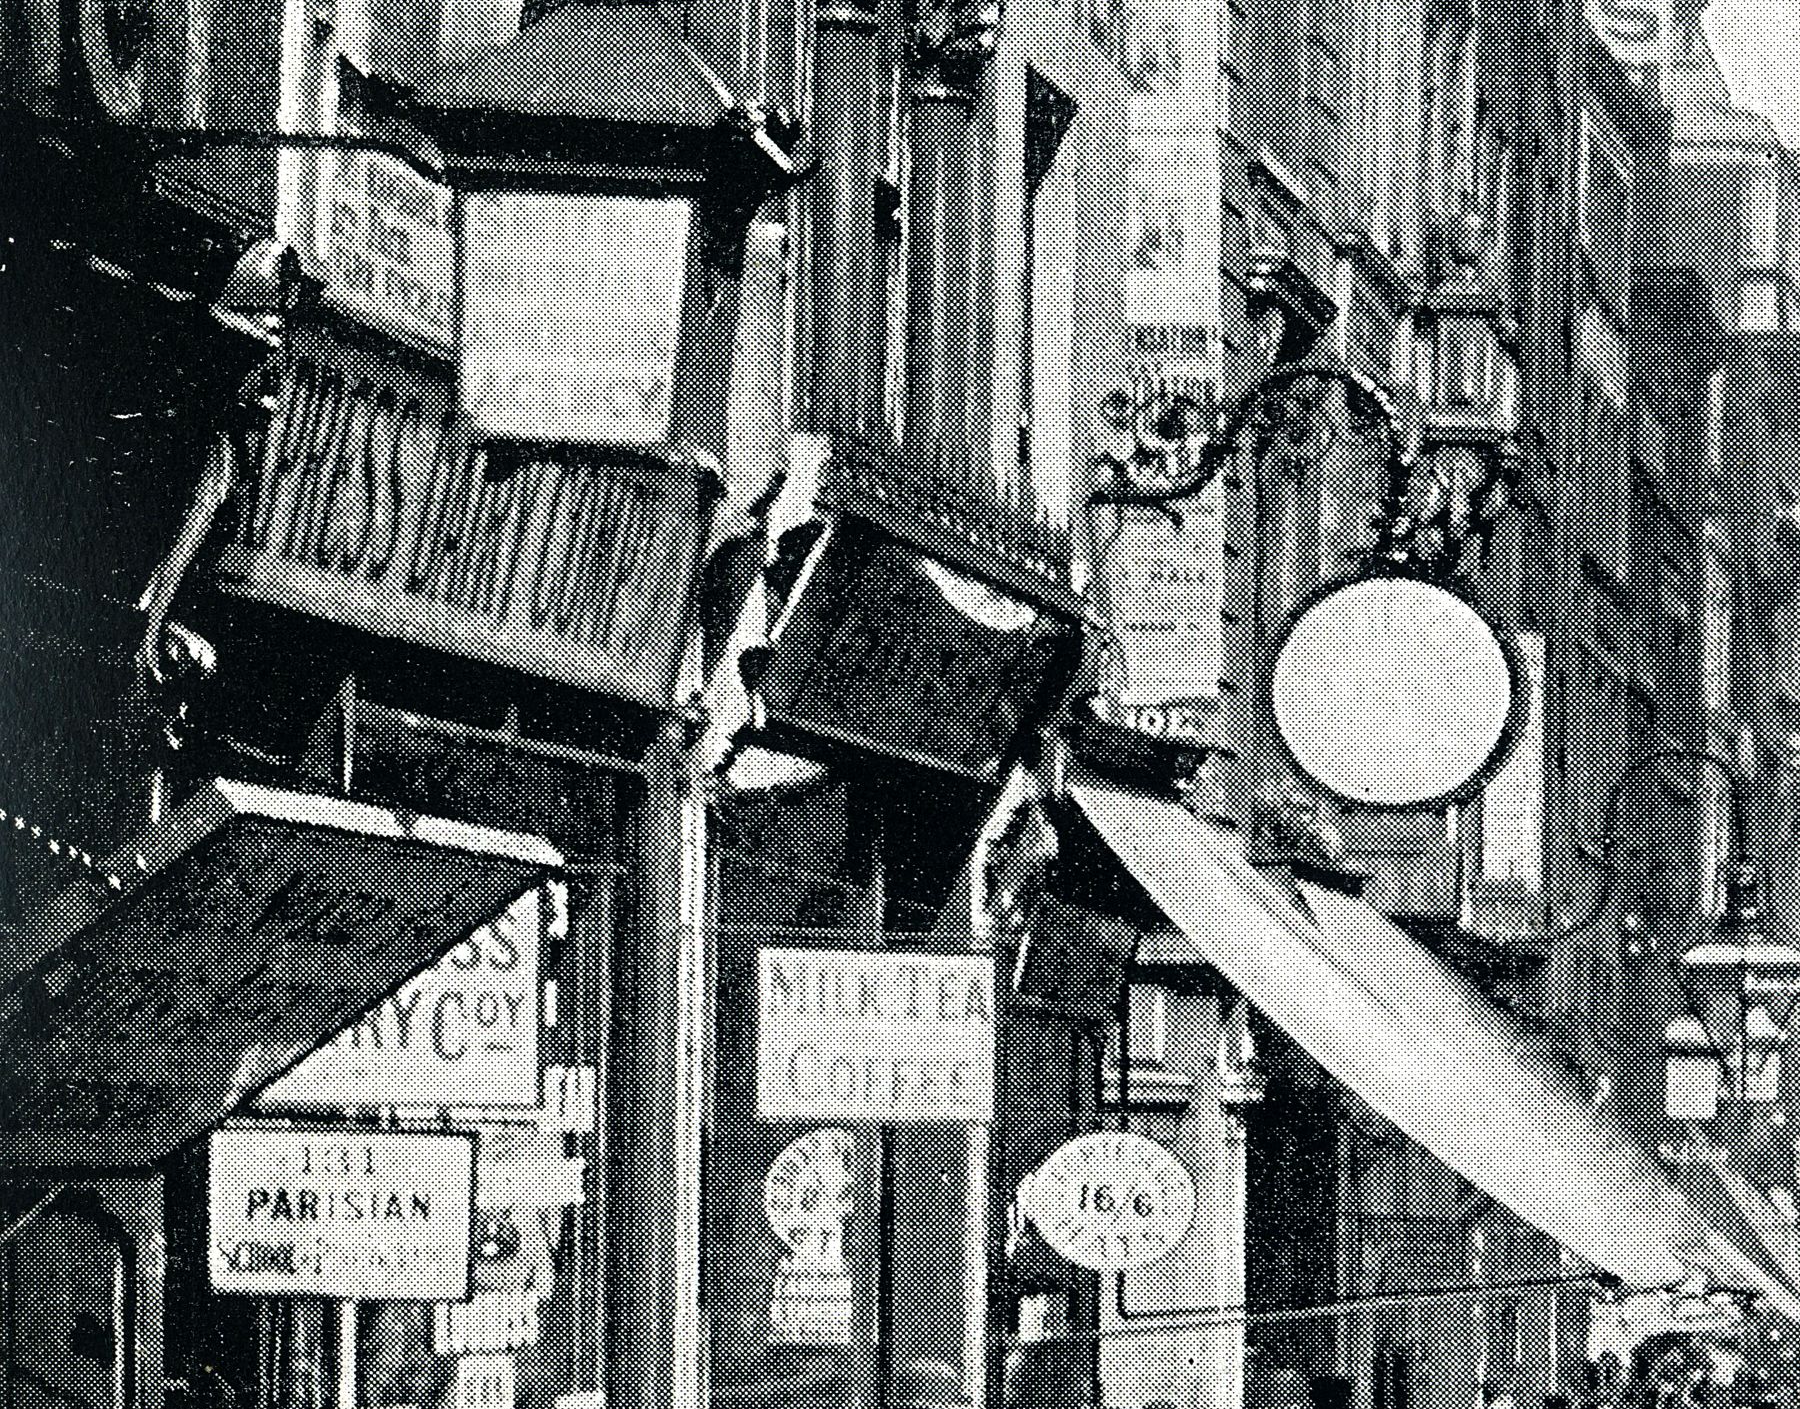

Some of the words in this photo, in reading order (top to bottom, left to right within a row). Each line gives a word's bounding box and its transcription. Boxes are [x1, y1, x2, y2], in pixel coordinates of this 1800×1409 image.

[769, 961, 884, 1018] MILK
[899, 964, 990, 1024] TEA
[786, 1041, 977, 1108] COFFEE
[246, 1187, 434, 1222] PARISIAN
